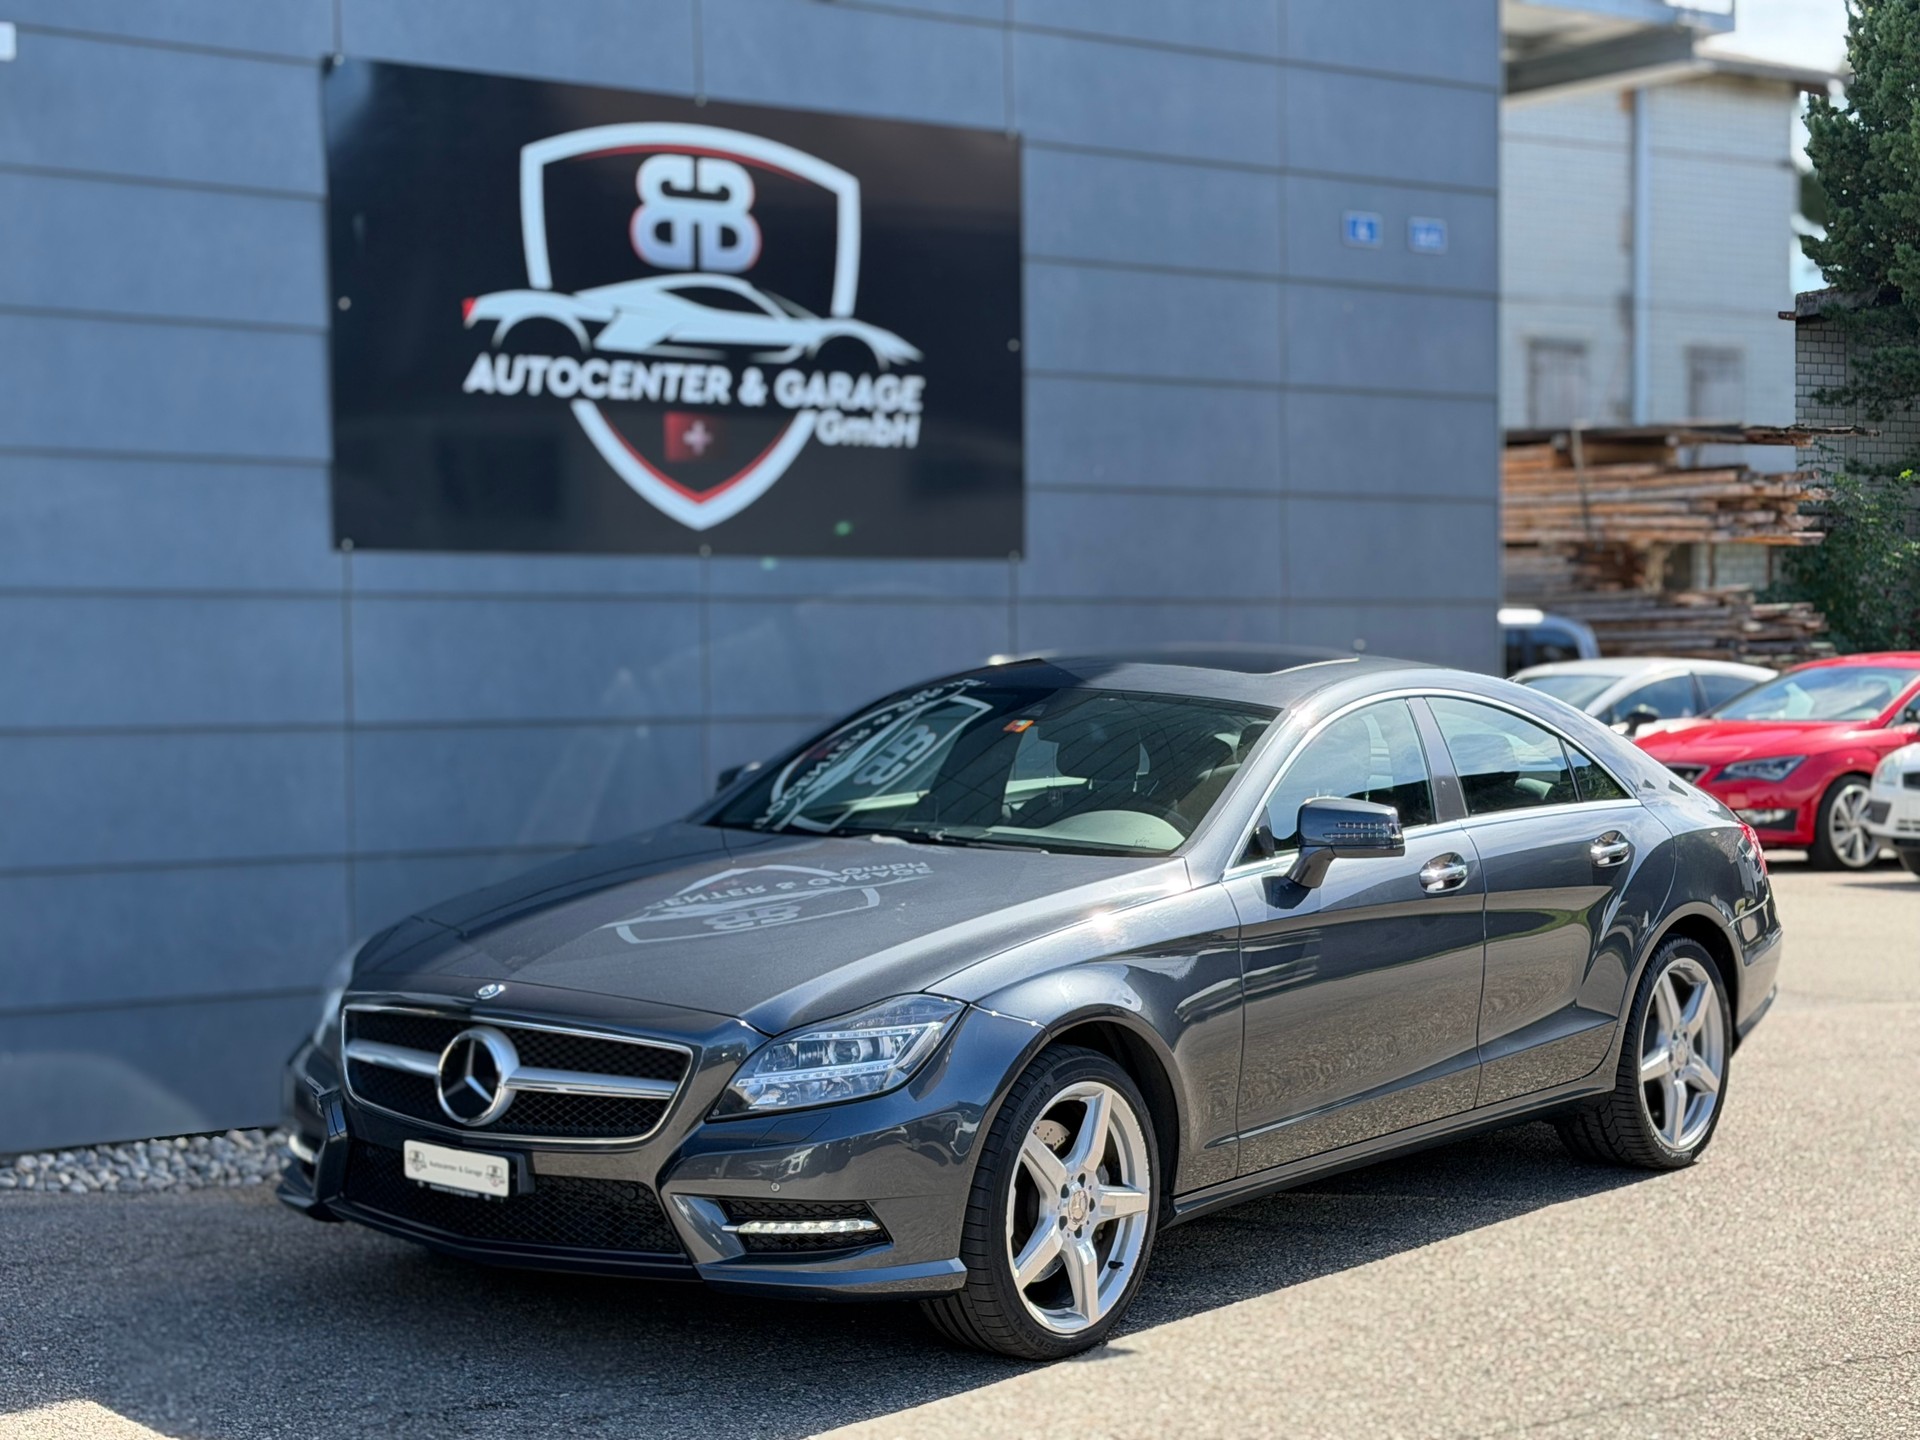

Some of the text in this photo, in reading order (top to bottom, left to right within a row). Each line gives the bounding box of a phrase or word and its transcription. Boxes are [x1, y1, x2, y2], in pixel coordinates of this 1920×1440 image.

[462, 352, 926, 414] AUTOCENTER & GARAGE
[815, 408, 922, 448] GmbH
